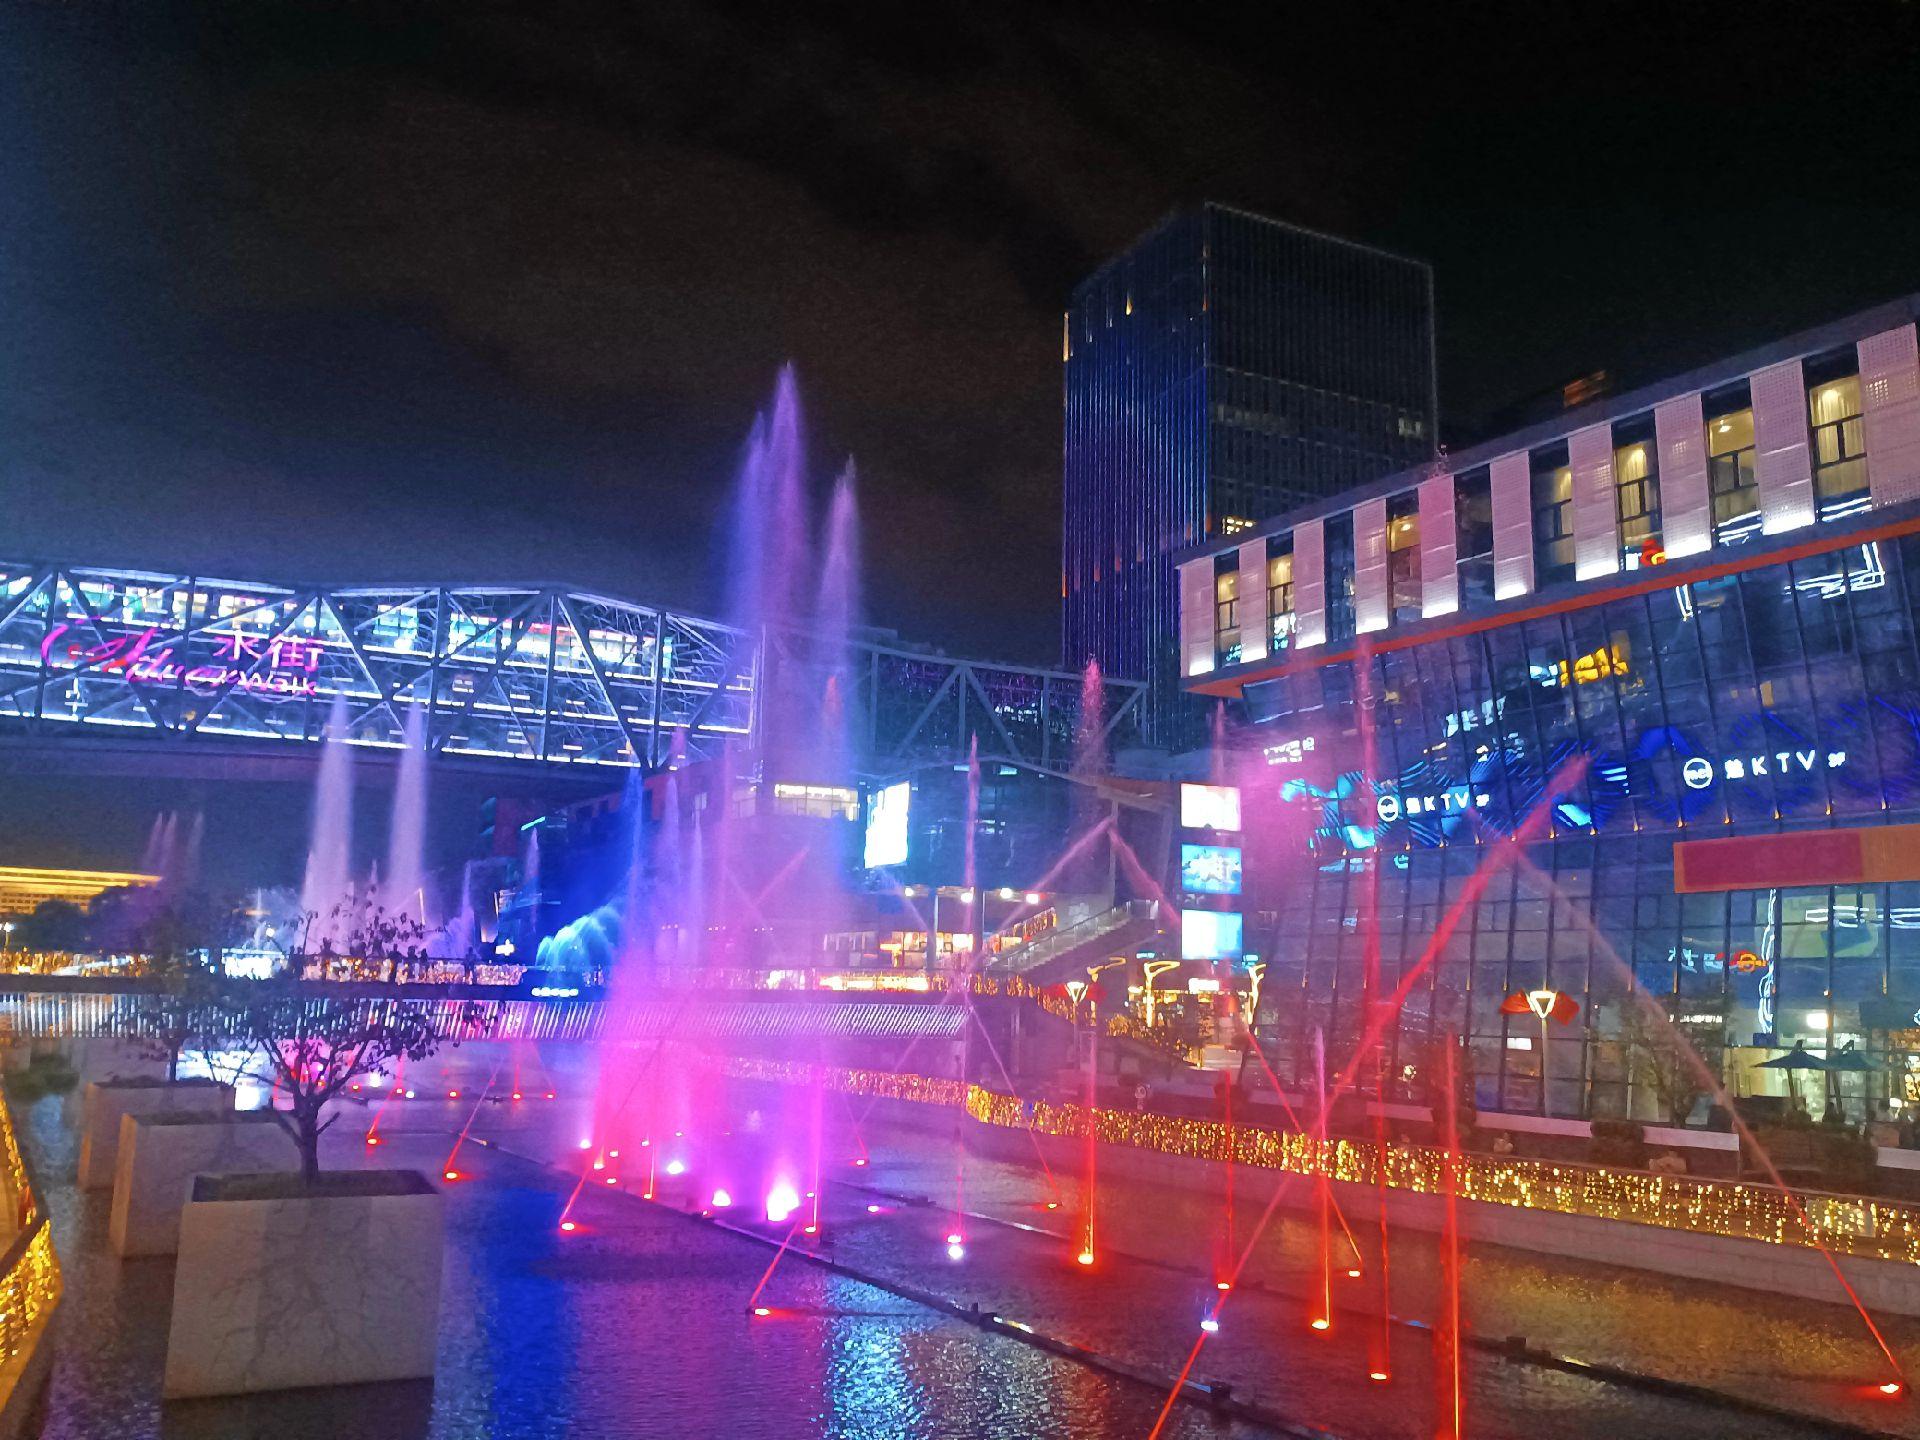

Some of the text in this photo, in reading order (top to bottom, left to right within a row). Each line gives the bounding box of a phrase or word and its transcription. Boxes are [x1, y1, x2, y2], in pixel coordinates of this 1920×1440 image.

[213, 630, 324, 671] 水街
[1725, 749, 1816, 780] KTV
[1406, 791, 1469, 814] KTV
